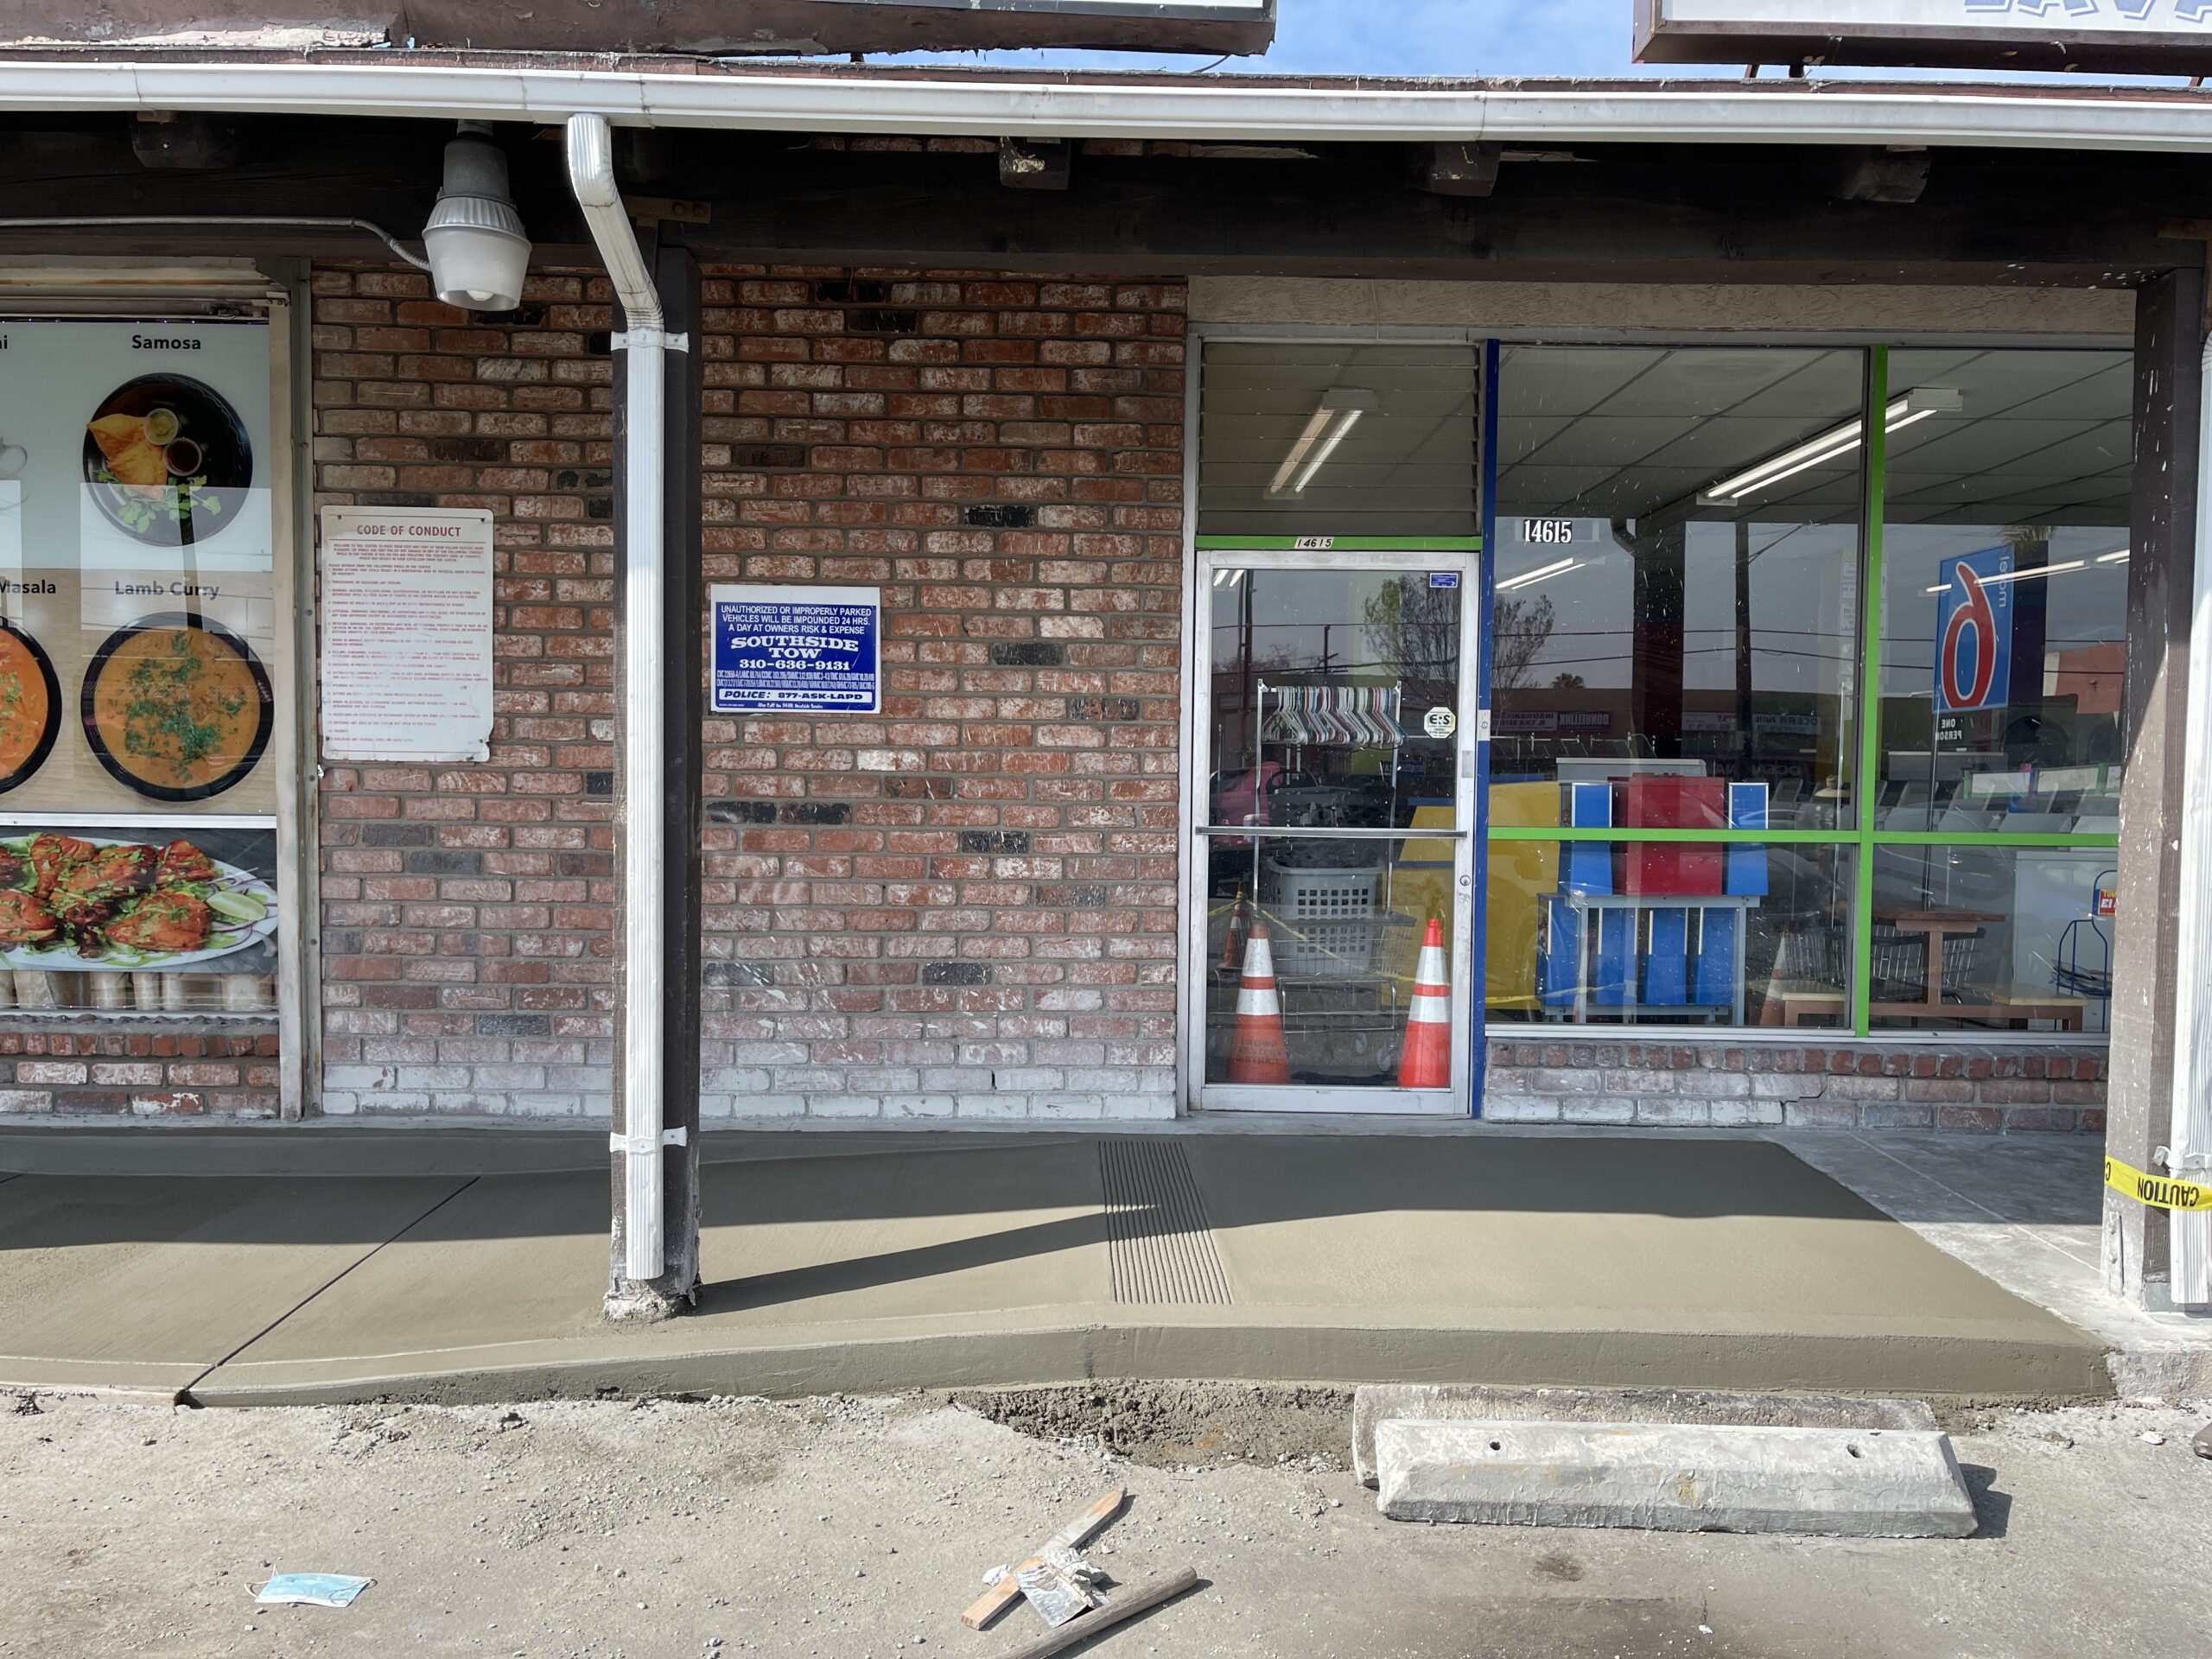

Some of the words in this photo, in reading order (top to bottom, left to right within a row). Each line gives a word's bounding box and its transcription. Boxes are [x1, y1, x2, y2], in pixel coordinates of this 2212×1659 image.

[131, 334, 201, 350] Samosa
[356, 524, 385, 536] CODE
[391, 525, 404, 536] OF
[409, 525, 461, 537] CONDUCT
[1524, 519, 1572, 543] 14615
[1297, 538, 1332, 548] 14615
[115, 581, 164, 595] Lamb
[169, 582, 220, 601] Curry
[721, 606, 778, 614] UNAUTHORIZED
[792, 607, 838, 615] IMPROPERLY
[722, 614, 760, 623] VEHICLES
[793, 616, 841, 625] IMPOUNDED
[852, 617, 871, 626] HRS.
[731, 635, 859, 652] SOUTHSIDE
[768, 648, 822, 658] TOW
[740, 659, 850, 671] 310-636-9131
[1429, 714, 1450, 725] ERS
[2137, 1177, 2200, 1207] CAUTION
